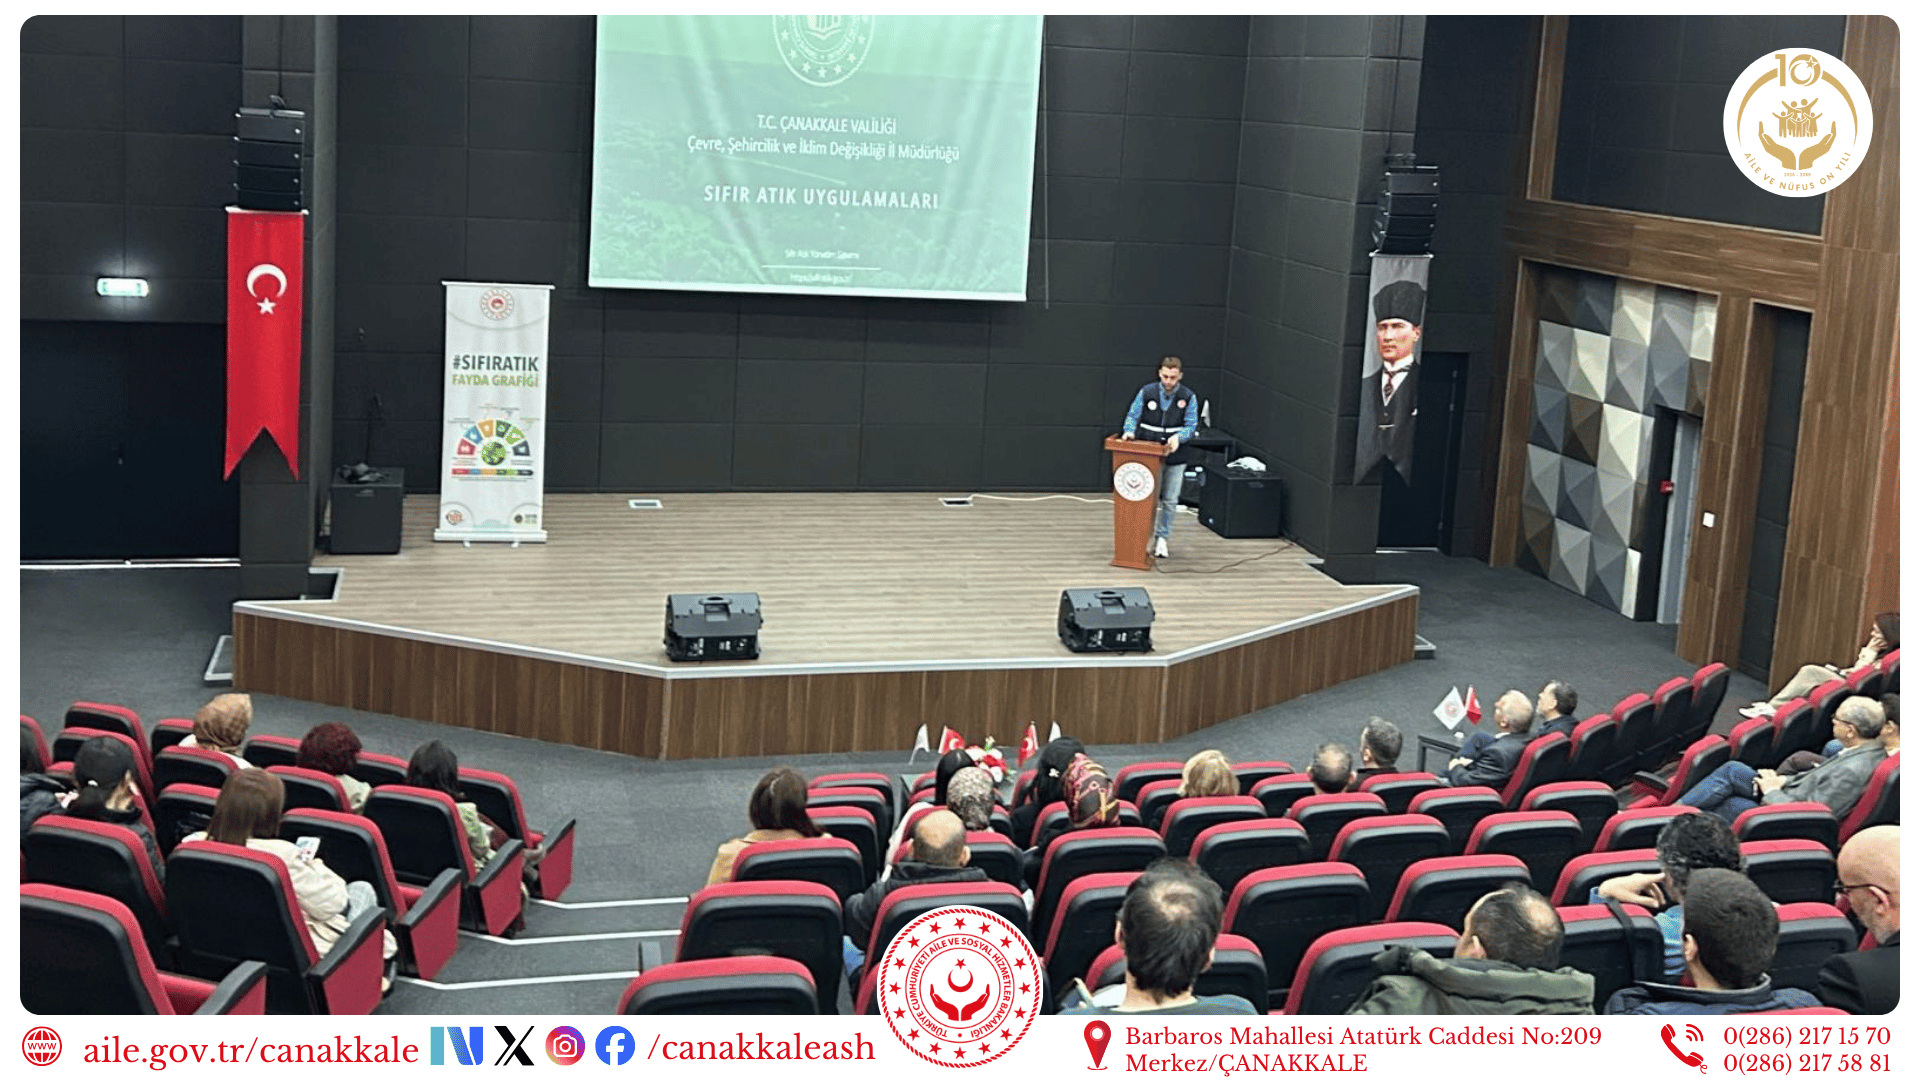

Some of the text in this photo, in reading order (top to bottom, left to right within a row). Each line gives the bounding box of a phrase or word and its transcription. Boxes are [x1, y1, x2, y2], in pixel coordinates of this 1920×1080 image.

[757, 114, 898, 136] T.C. ÇANAKKALE VALİLİĞİ
[687, 136, 960, 164] Çevre, Şehircilik ve İklim Değişikliği İl Müdürlüğü
[703, 185, 939, 209] SIFIR ATIK UYGULAMALARI
[452, 354, 539, 372] #SIFIRATIK
[452, 373, 539, 388] FAYDA GRAFİĞİ
